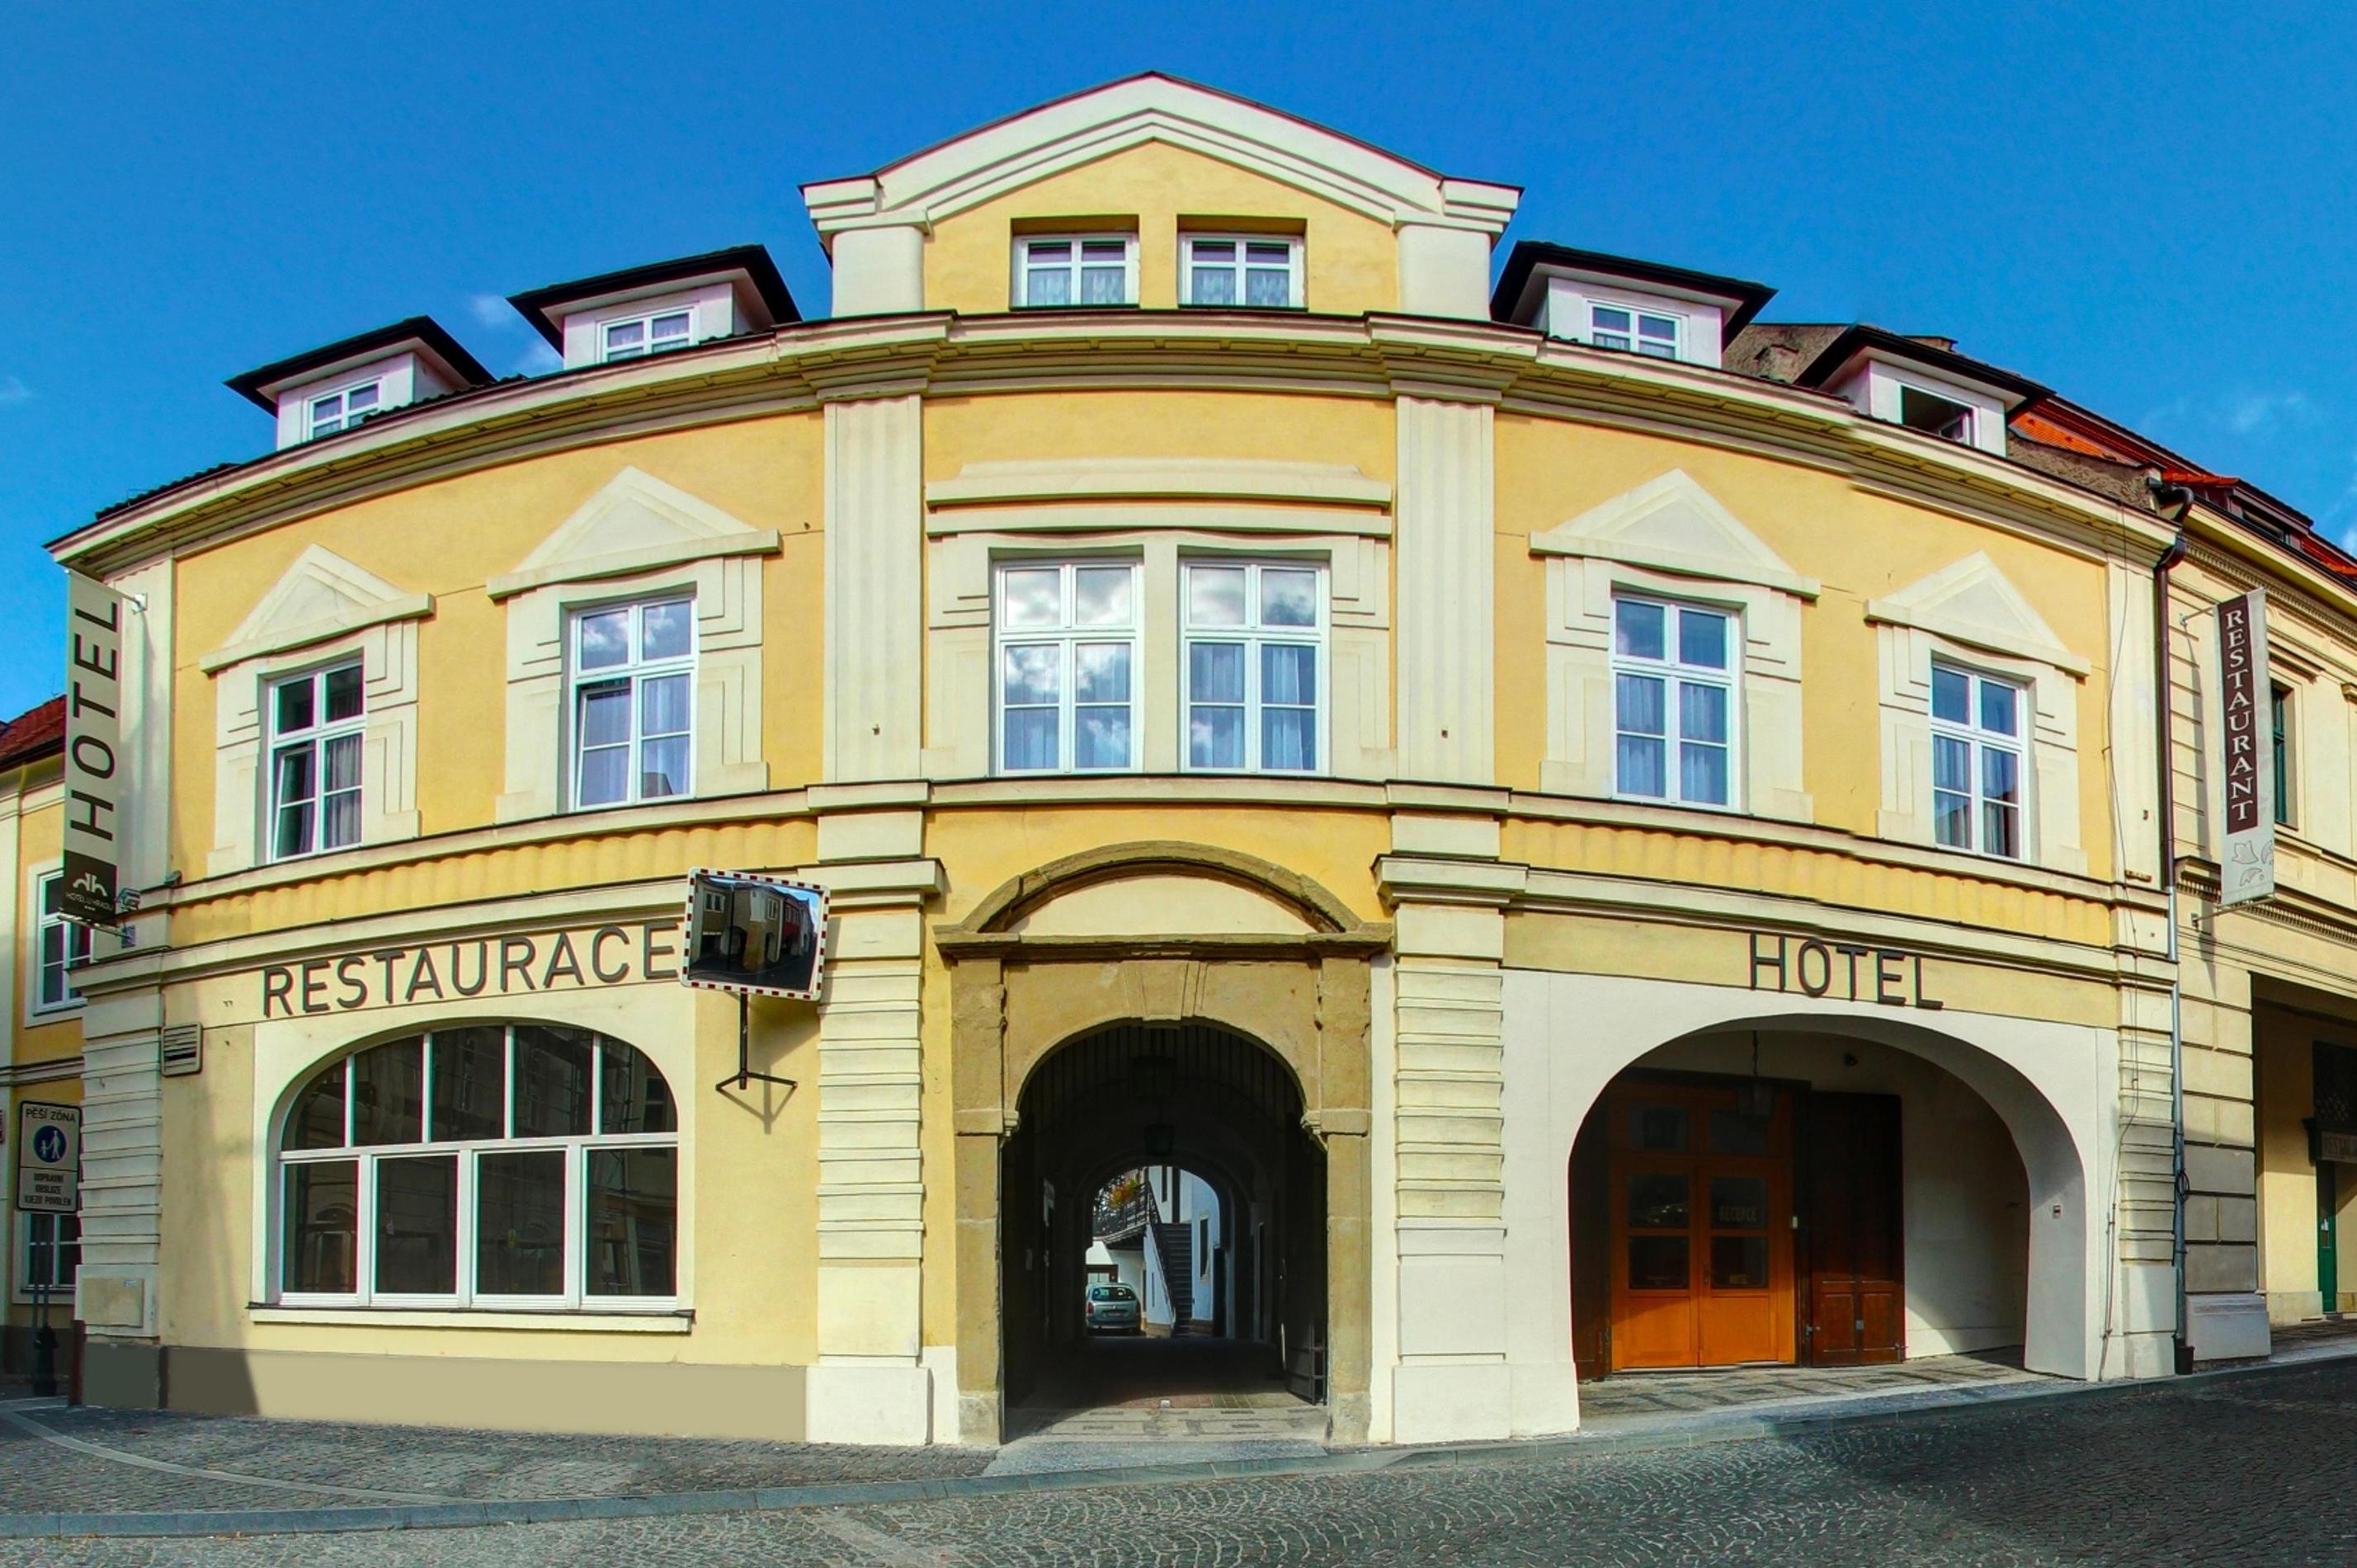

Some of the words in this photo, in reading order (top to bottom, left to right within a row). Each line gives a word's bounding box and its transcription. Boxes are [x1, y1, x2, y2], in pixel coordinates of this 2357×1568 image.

[70, 601, 118, 841] HOTEL
[2226, 609, 2254, 821] RESTAURANT
[262, 921, 680, 1019] RESTAURACE
[1750, 930, 1944, 1010] HOTEL
